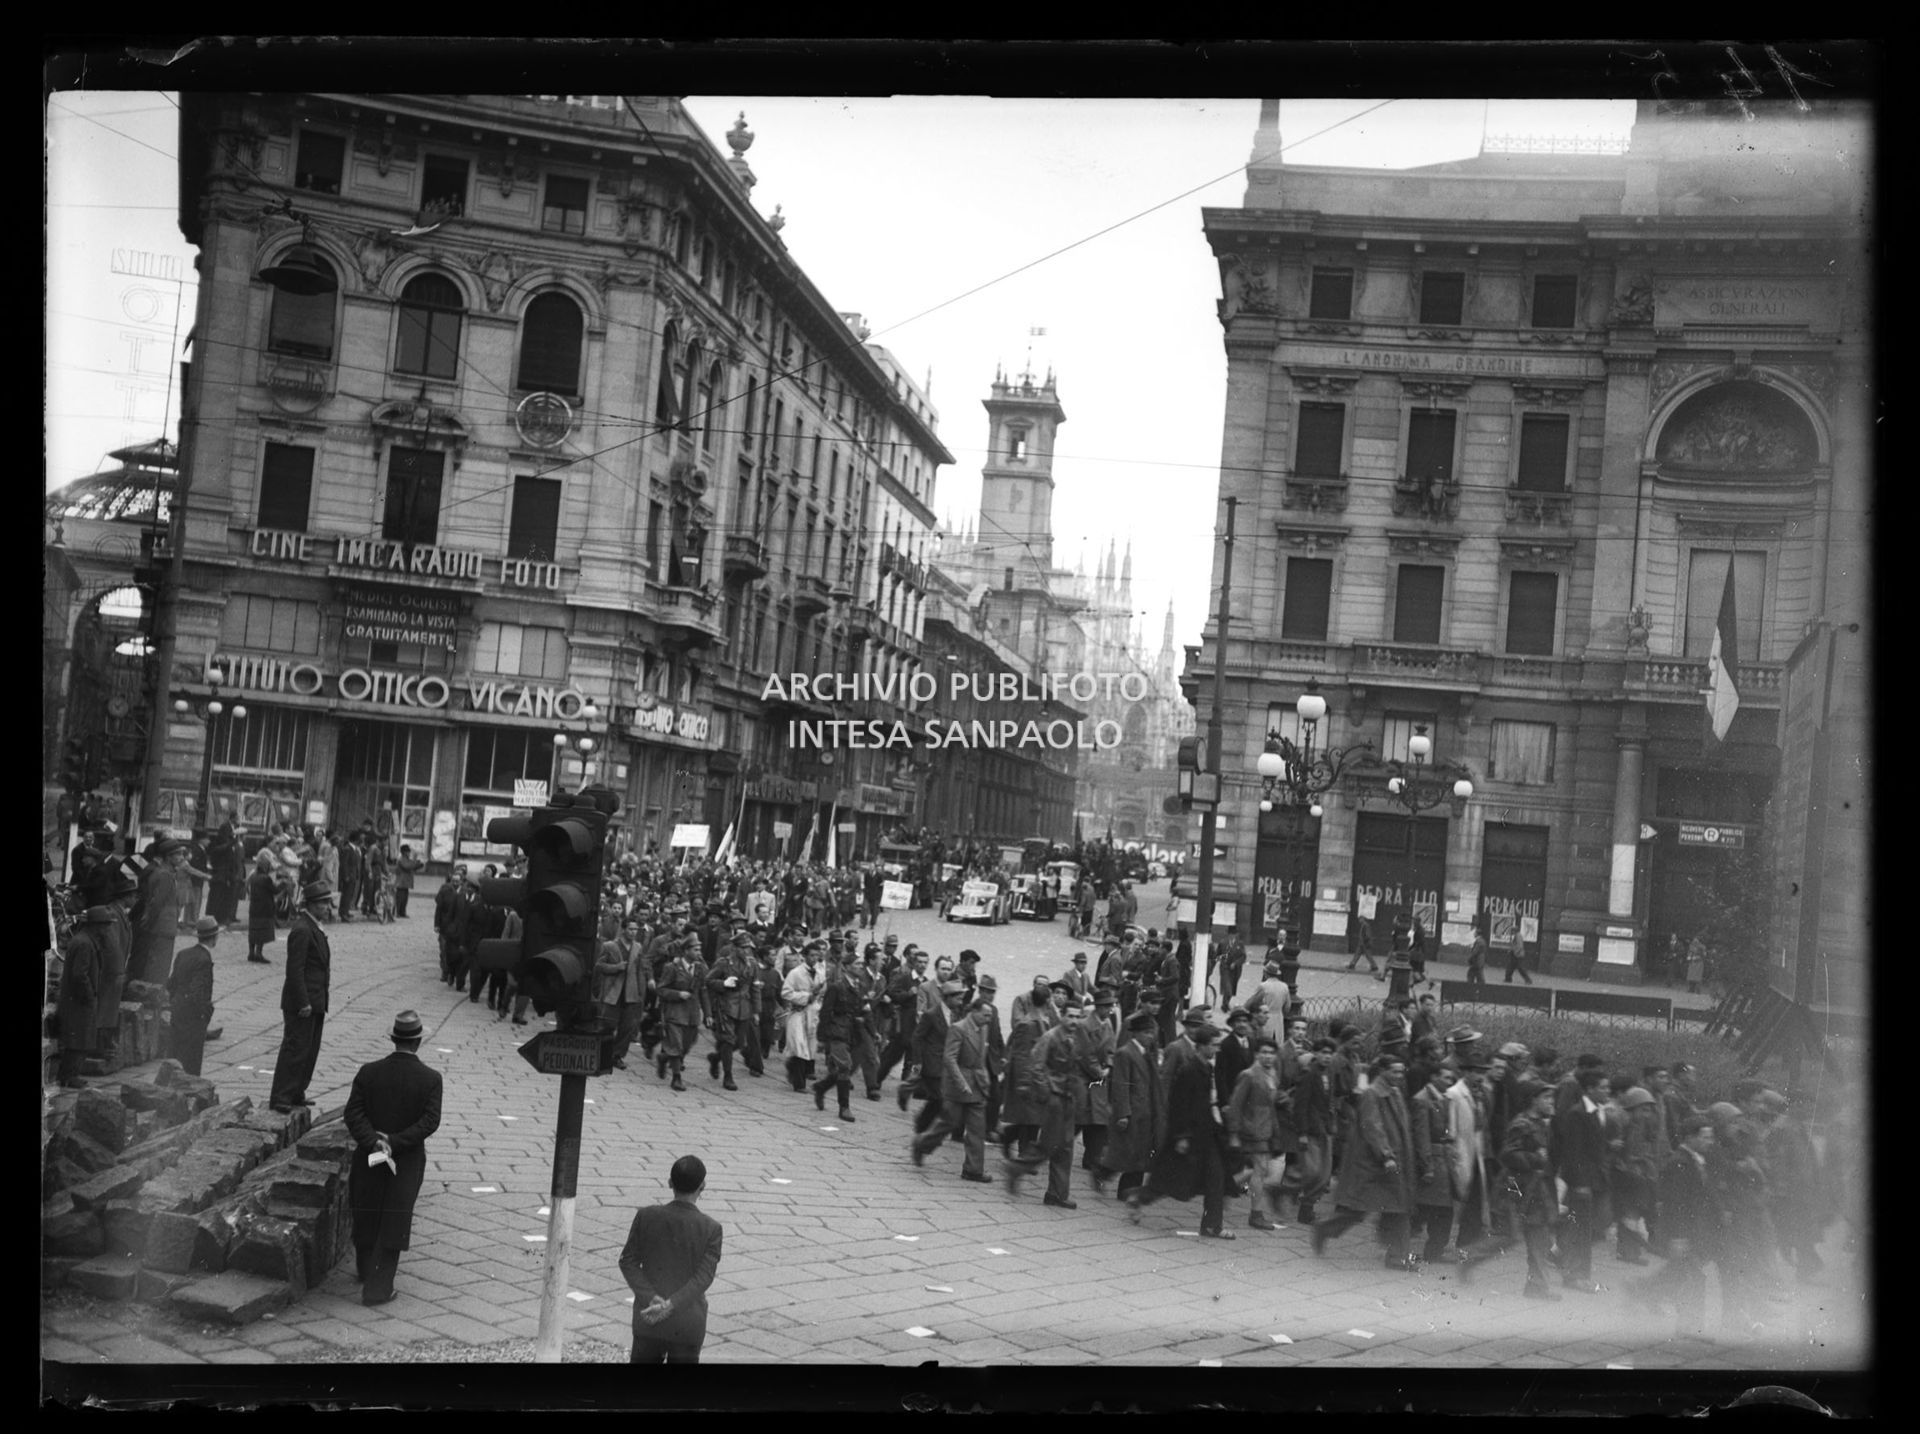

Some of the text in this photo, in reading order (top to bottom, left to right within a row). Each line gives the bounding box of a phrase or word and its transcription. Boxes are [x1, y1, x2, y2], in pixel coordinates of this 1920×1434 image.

[1456, 357, 1532, 372] GRANDINE
[252, 529, 314, 561] CINE
[500, 559, 561, 590] FOTO
[346, 606, 456, 630] ESAMINANO LA VISTA
[338, 668, 450, 708] OTTICO
[465, 672, 586, 720] VIGANÒ
[543, 1052, 596, 1071] PEDONALE
